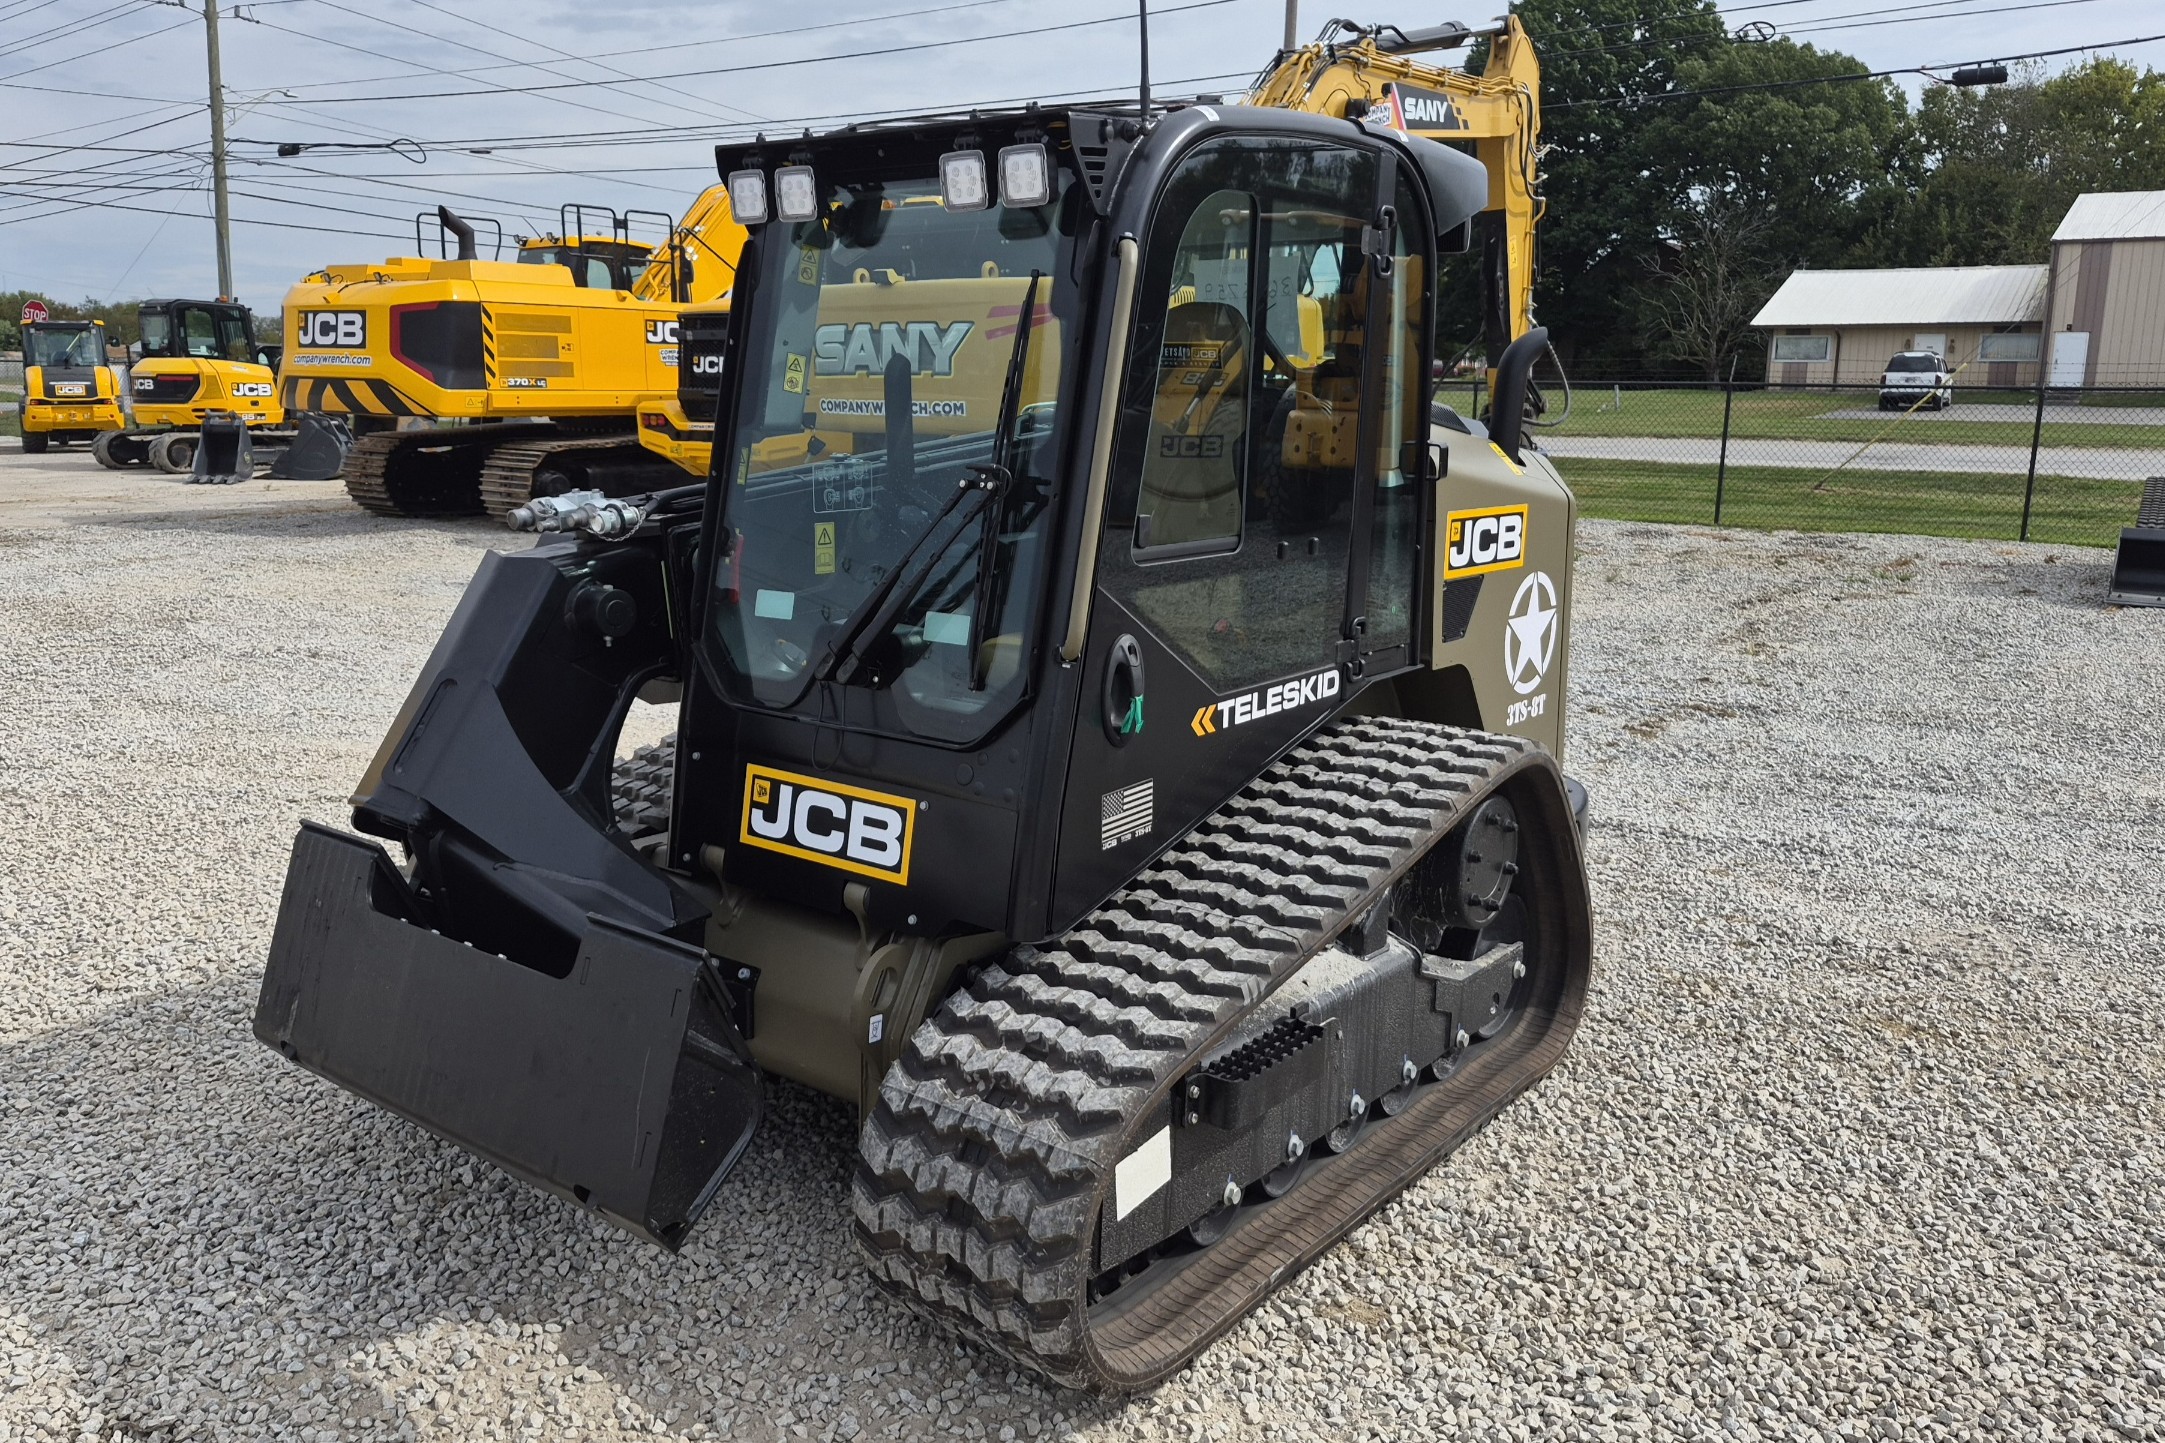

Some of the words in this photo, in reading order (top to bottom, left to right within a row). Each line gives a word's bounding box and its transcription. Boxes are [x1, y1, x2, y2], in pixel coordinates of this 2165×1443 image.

[1404, 97, 1448, 123] SANY
[24, 308, 47, 321] STOP
[298, 312, 364, 345] JCB
[646, 321, 680, 344] JC
[293, 353, 371, 367] companywrench.com
[814, 321, 975, 376] SANY
[133, 378, 154, 390] JCB
[232, 383, 272, 396] JCB
[1160, 435, 1223, 457] JCB
[1449, 515, 1522, 568] JCB
[1217, 669, 1340, 729] TELESKID
[1506, 693, 1547, 727] 3TS-8T
[750, 784, 903, 868] JCB
